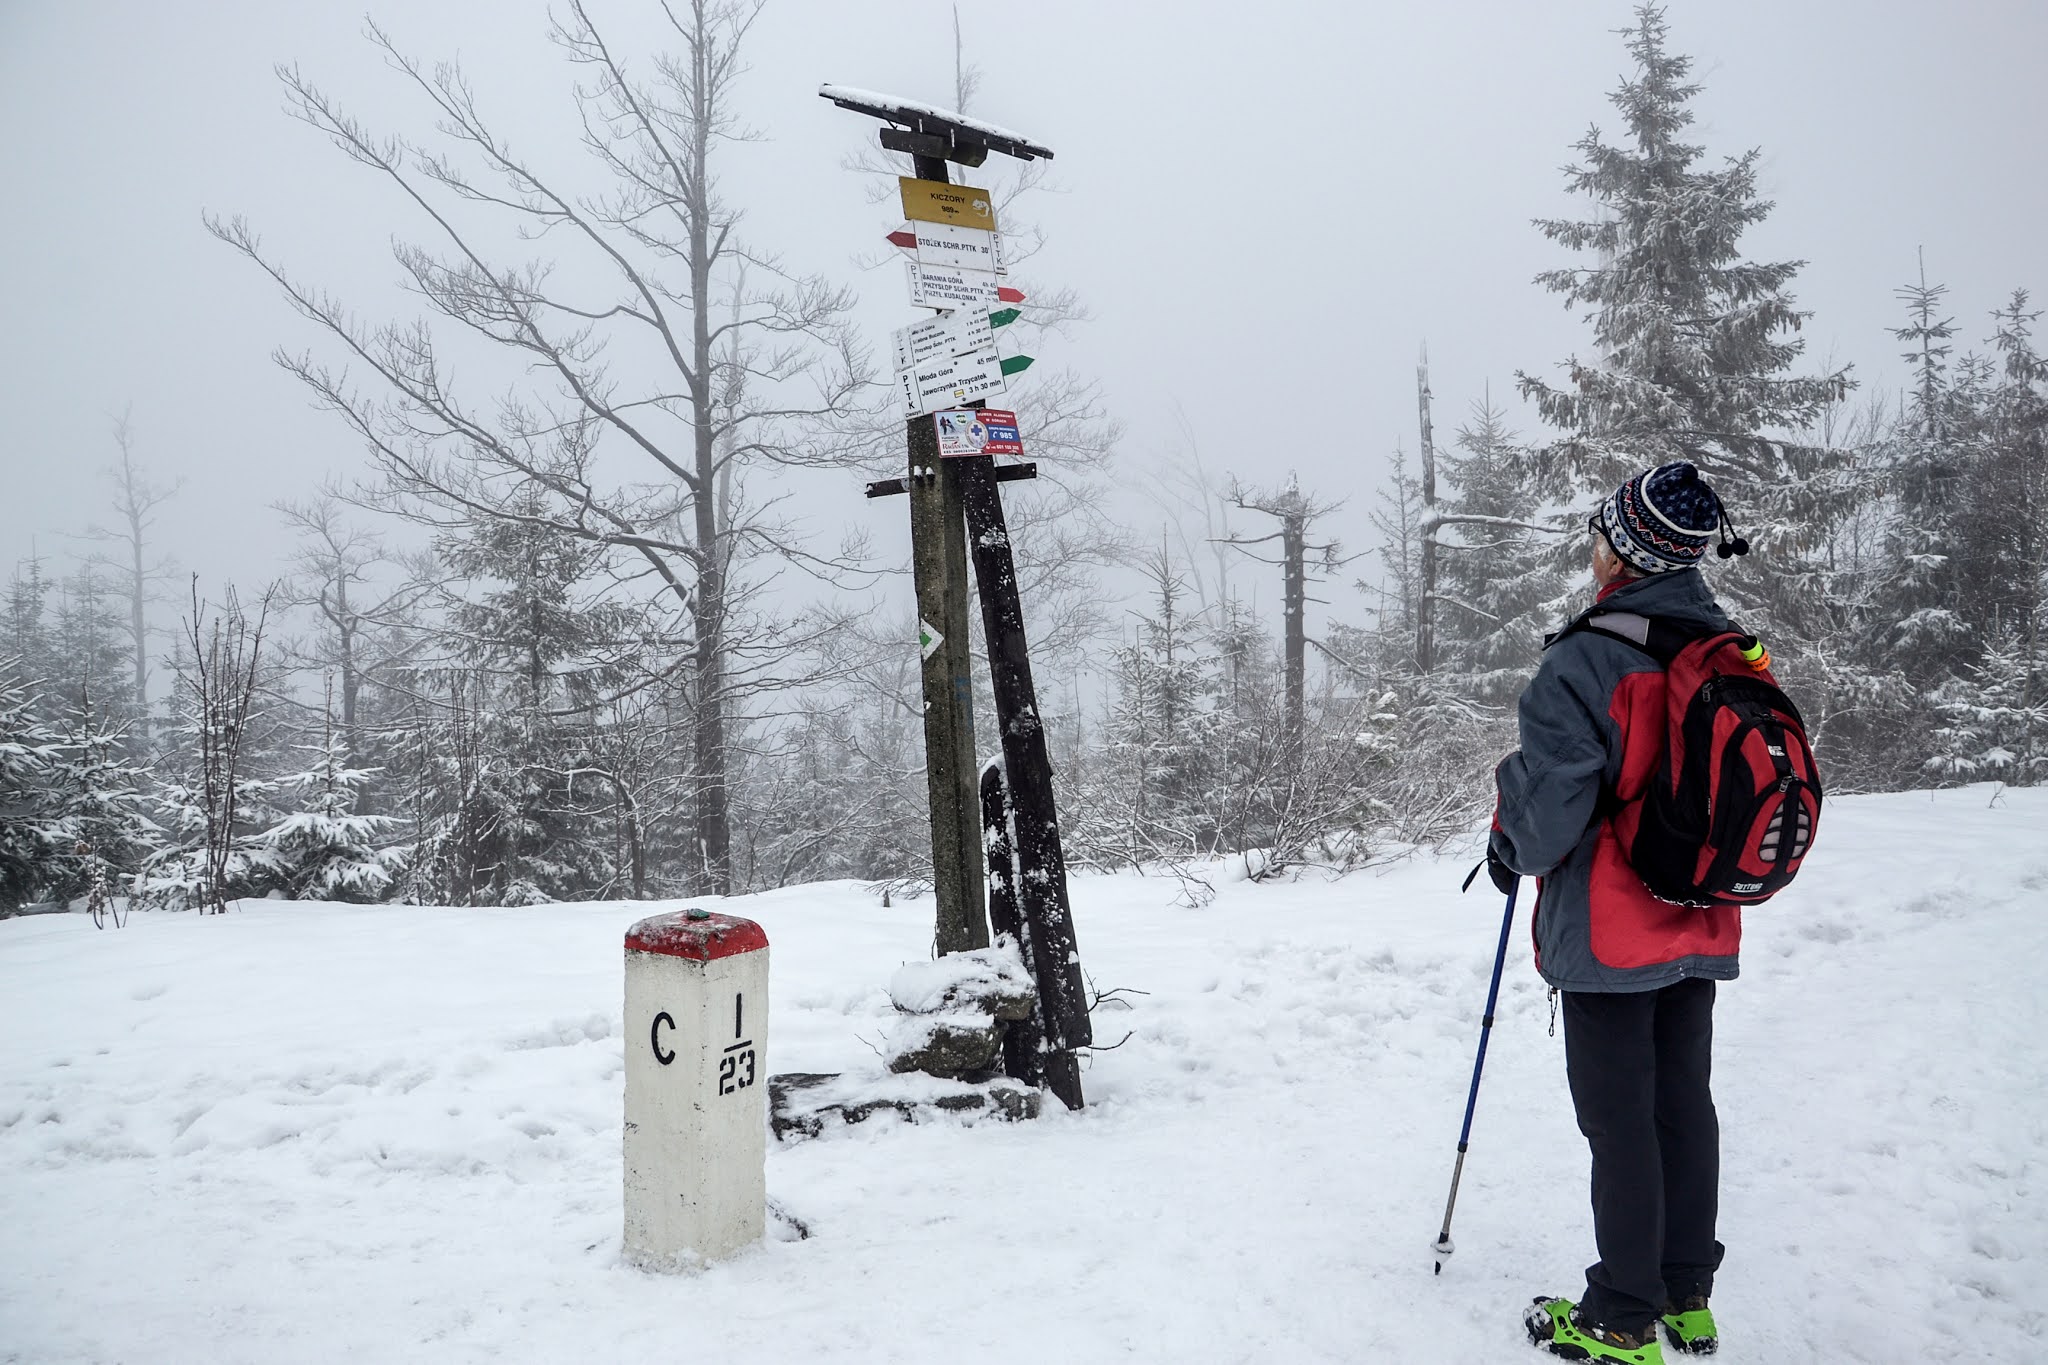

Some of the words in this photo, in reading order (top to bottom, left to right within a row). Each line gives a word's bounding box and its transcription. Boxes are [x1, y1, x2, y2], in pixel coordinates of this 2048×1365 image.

[930, 192, 966, 204] KICZORY
[918, 373, 937, 383] Młoda
[938, 368, 953, 377] Góra
[985, 354, 998, 363] min
[902, 374, 915, 410] PTTK
[921, 382, 958, 397] Jaworzynka
[969, 386, 974, 394] 3
[980, 382, 989, 390] 30
[989, 379, 1002, 388] min
[1000, 431, 1013, 440] 985
[651, 1011, 676, 1066] C
[719, 1049, 756, 1096] 23
